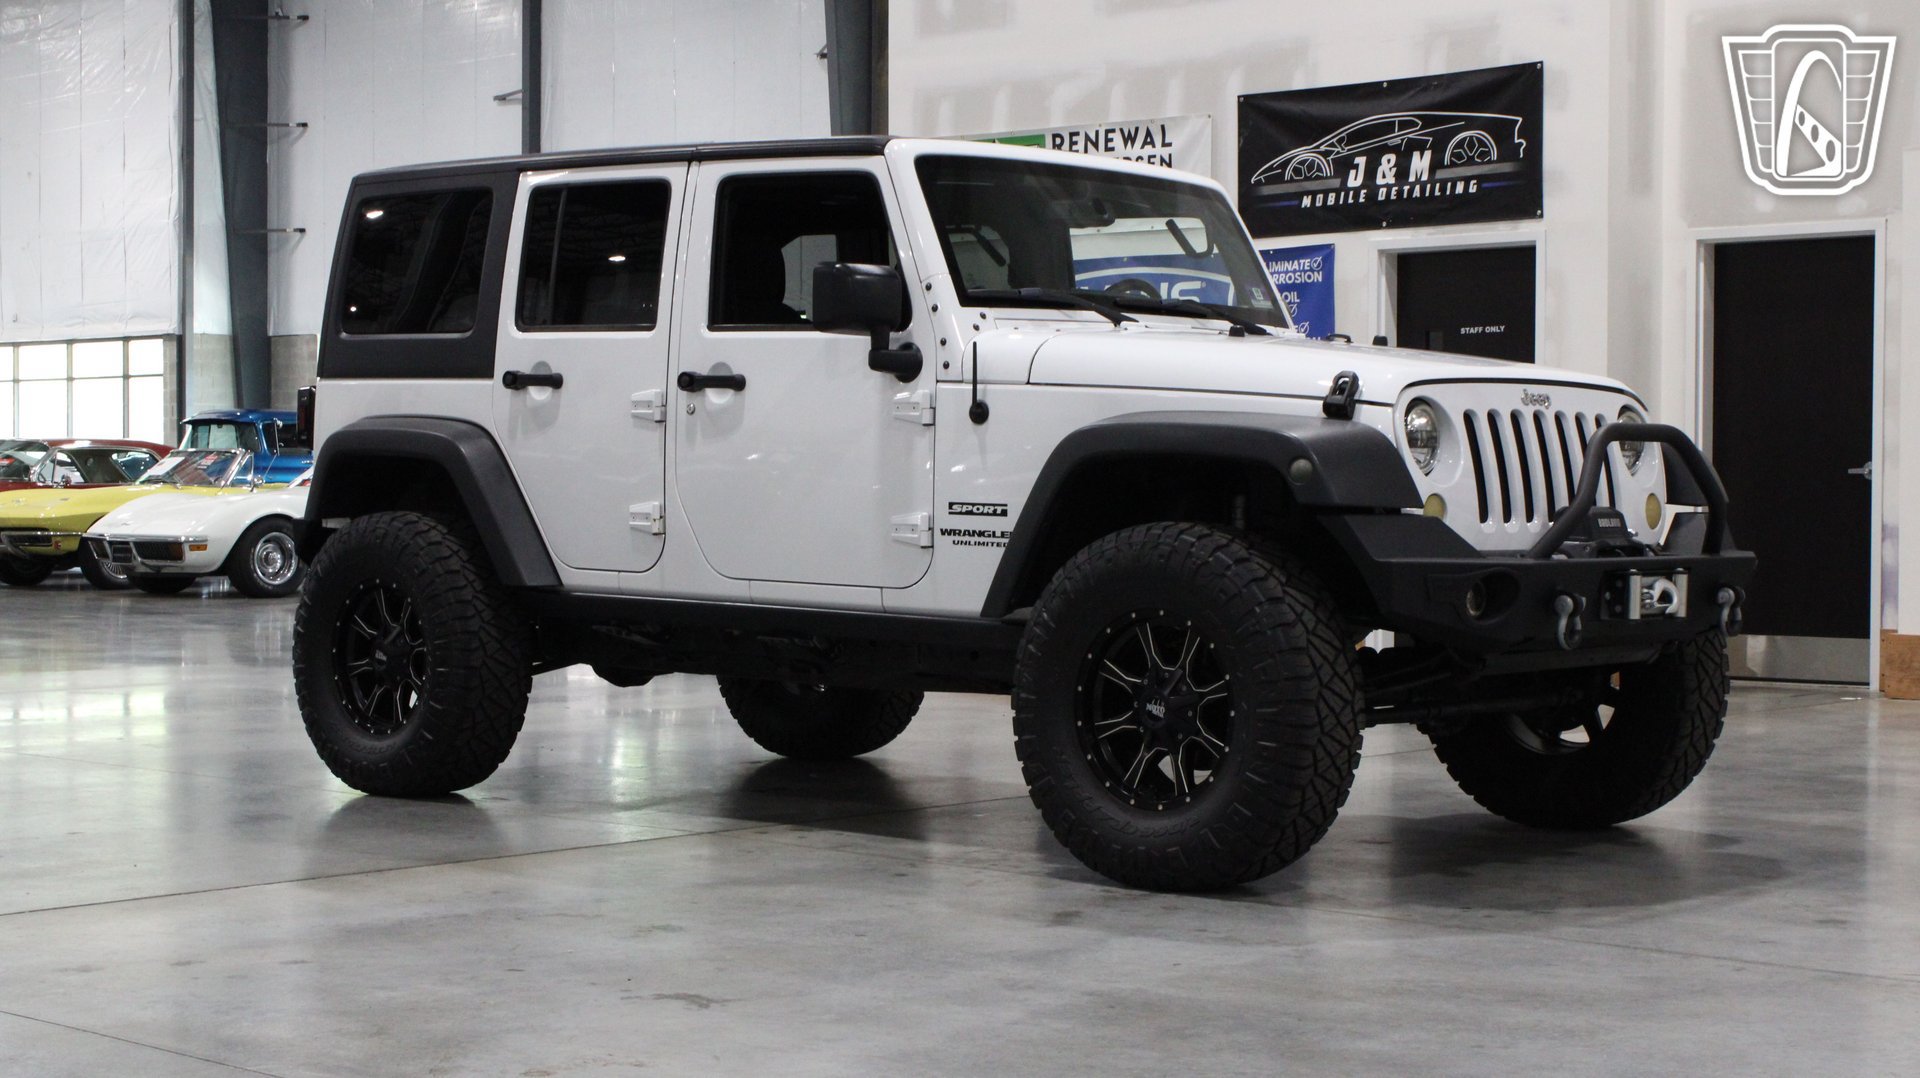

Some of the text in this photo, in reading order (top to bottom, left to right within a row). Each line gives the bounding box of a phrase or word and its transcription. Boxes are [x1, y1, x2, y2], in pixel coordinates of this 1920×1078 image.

[1051, 124, 1173, 153] RENEWAL
[1347, 150, 1432, 188] J & M
[1301, 180, 1478, 208] MOBILE DETAILING
[1268, 259, 1311, 272] IMINATE
[1272, 271, 1322, 285] RROSION
[1460, 325, 1505, 335] STAFF ONLY
[949, 504, 1008, 515] SPORT
[940, 528, 1013, 539] WRANGLE
